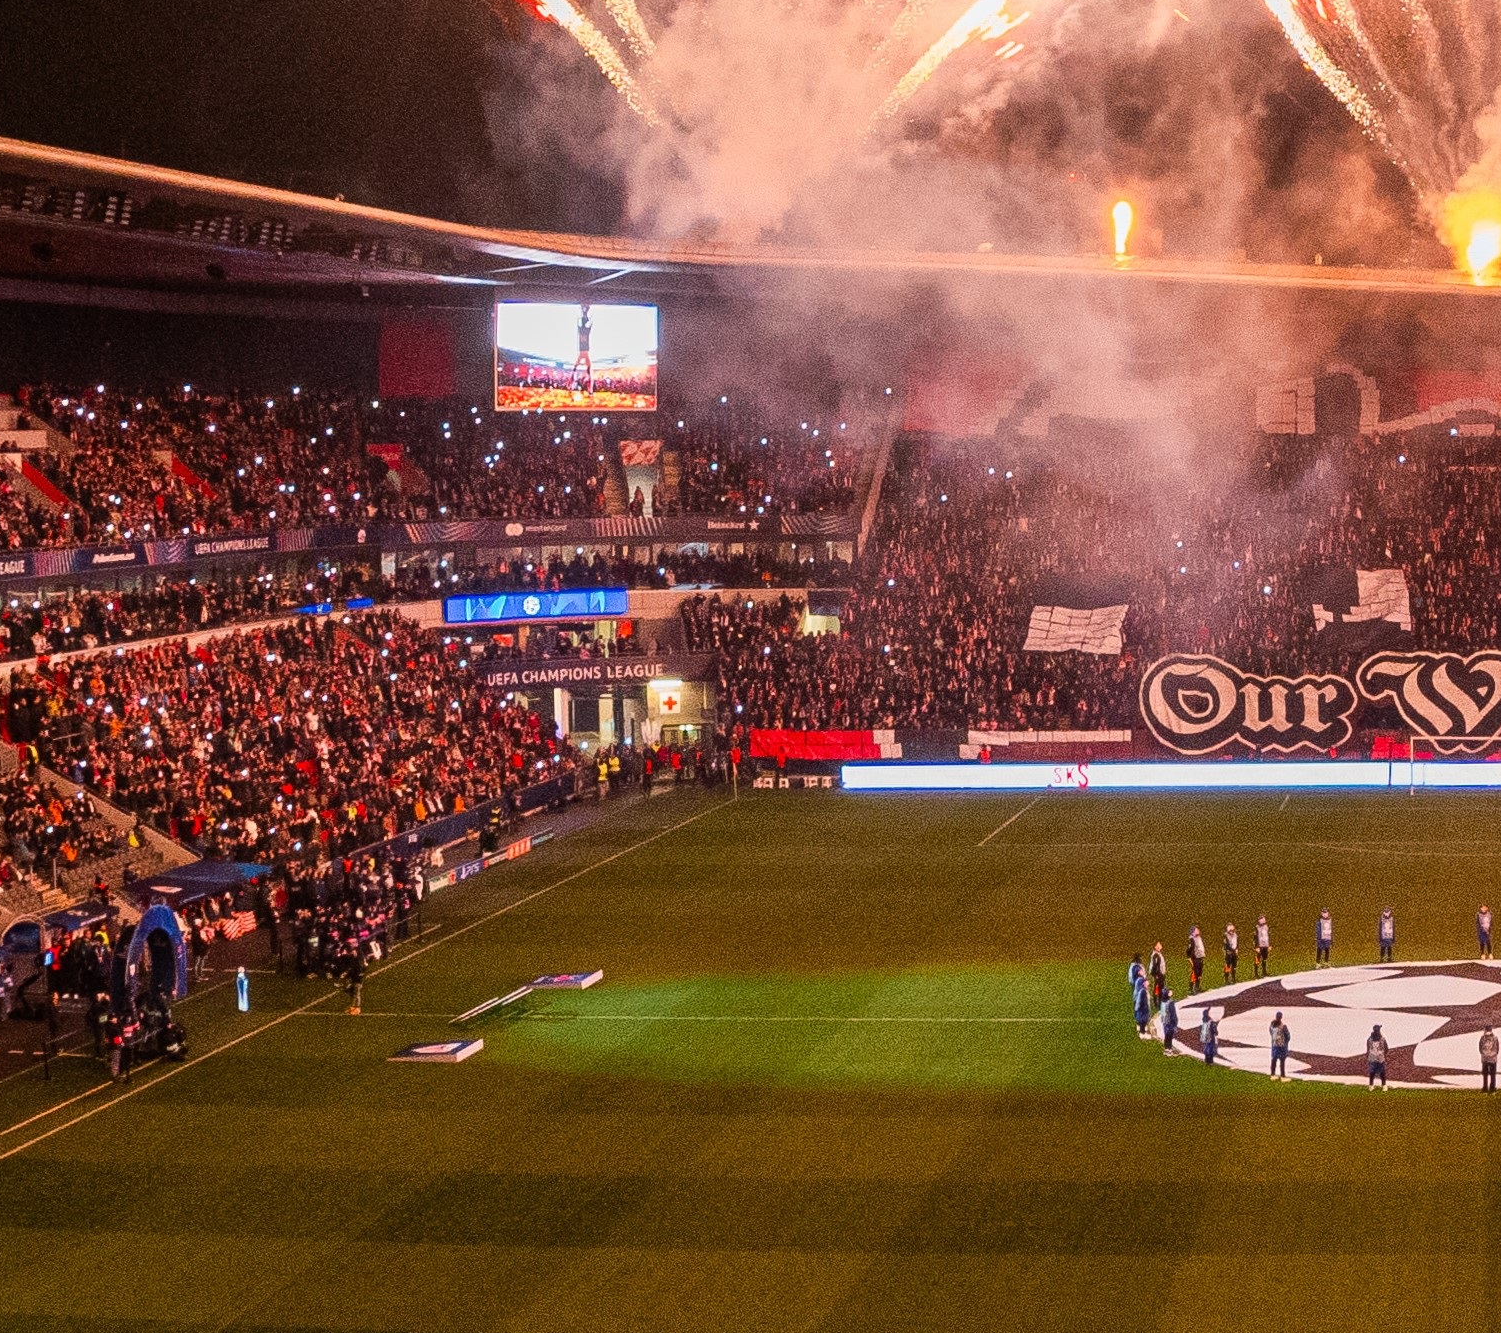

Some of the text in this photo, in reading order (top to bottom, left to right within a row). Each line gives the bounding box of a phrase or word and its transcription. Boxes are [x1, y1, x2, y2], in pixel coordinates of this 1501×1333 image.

[487, 663, 665, 687] UEFA CHAMPIONS LEAGUE
[1148, 662, 1340, 735] Our
[1054, 763, 1089, 788] SKS
